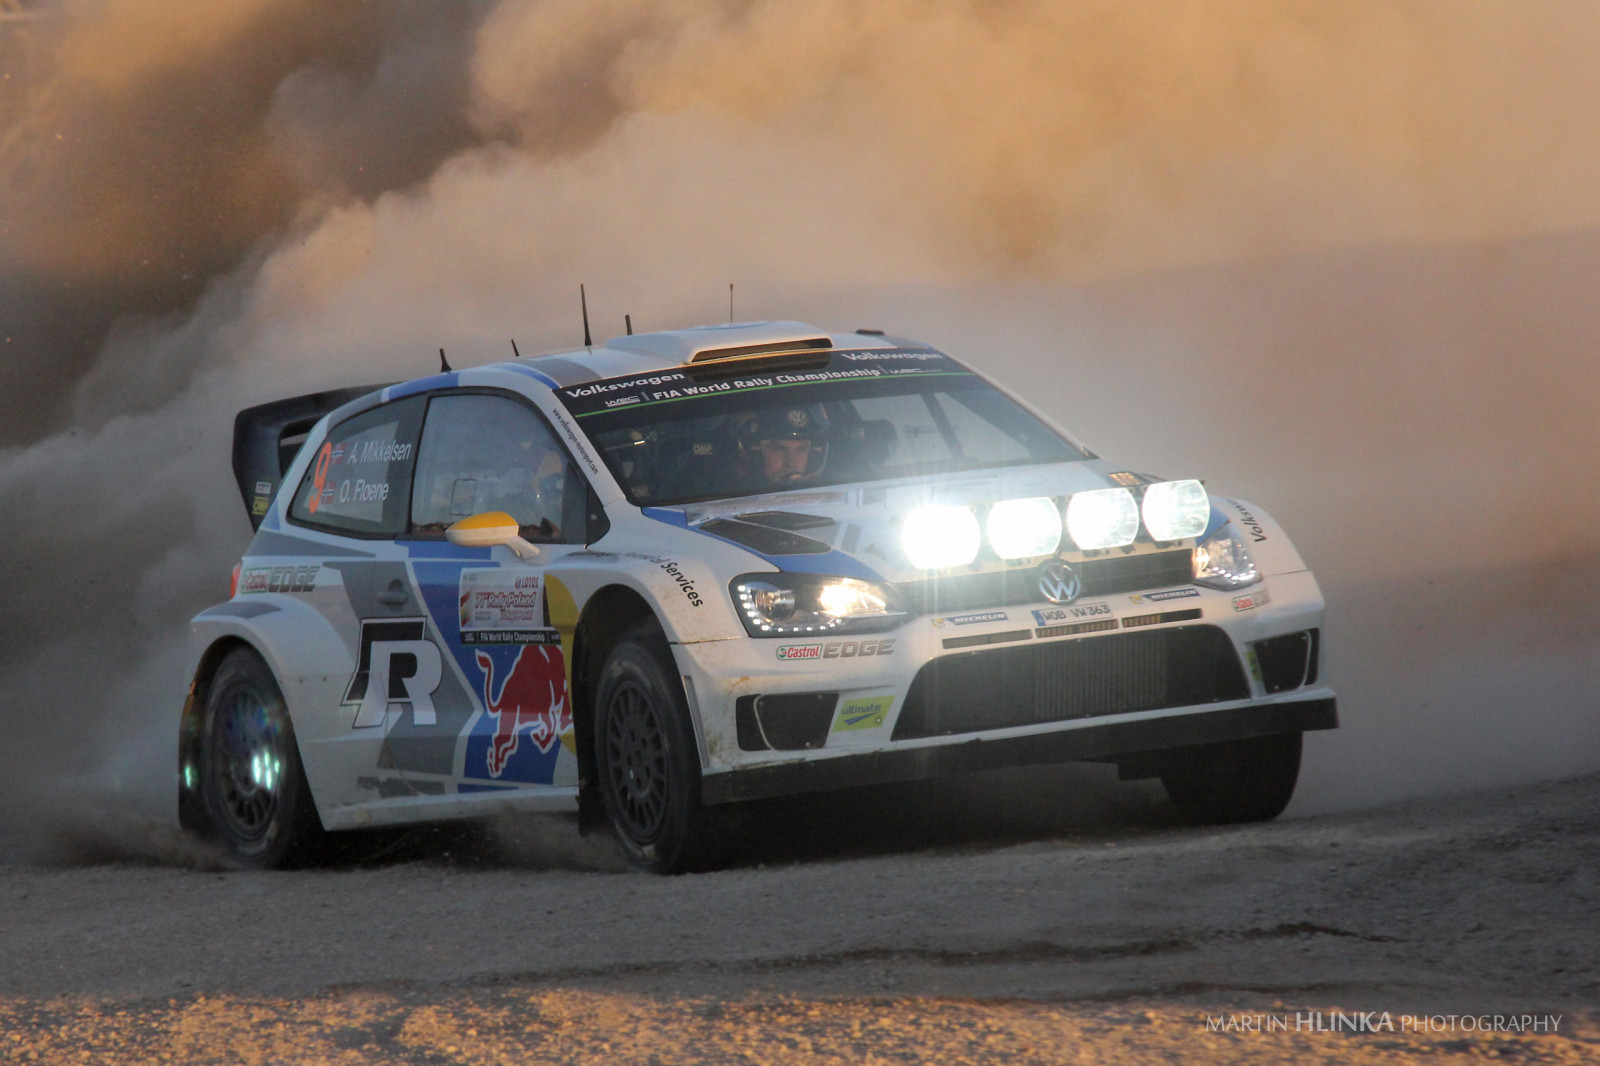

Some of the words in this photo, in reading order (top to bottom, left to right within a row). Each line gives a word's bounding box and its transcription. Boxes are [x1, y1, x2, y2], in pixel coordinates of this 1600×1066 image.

[842, 352, 944, 361] Volkswagen
[565, 373, 685, 398] Volkswagen
[605, 395, 640, 407] WRC
[653, 389, 682, 401] FIA
[682, 381, 731, 396] World
[733, 376, 773, 389] Rally
[776, 368, 881, 384] Championship
[347, 442, 358, 464] A.
[360, 439, 412, 462] Mikkelsen
[308, 441, 333, 514] 9
[340, 479, 351, 503] O.
[268, 566, 320, 592] EDGE
[660, 562, 704, 607] Services
[487, 591, 508, 610] Rally
[507, 591, 537, 608] Poland
[1151, 588, 1198, 600] MICHELIN
[954, 612, 1006, 625] MICHELIN
[1042, 610, 1066, 621] WOB
[1070, 607, 1087, 617] VW
[1087, 605, 1111, 615] 363
[787, 646, 820, 659] Castrol
[823, 639, 897, 659] EDGE
[842, 703, 882, 715] ultimate
